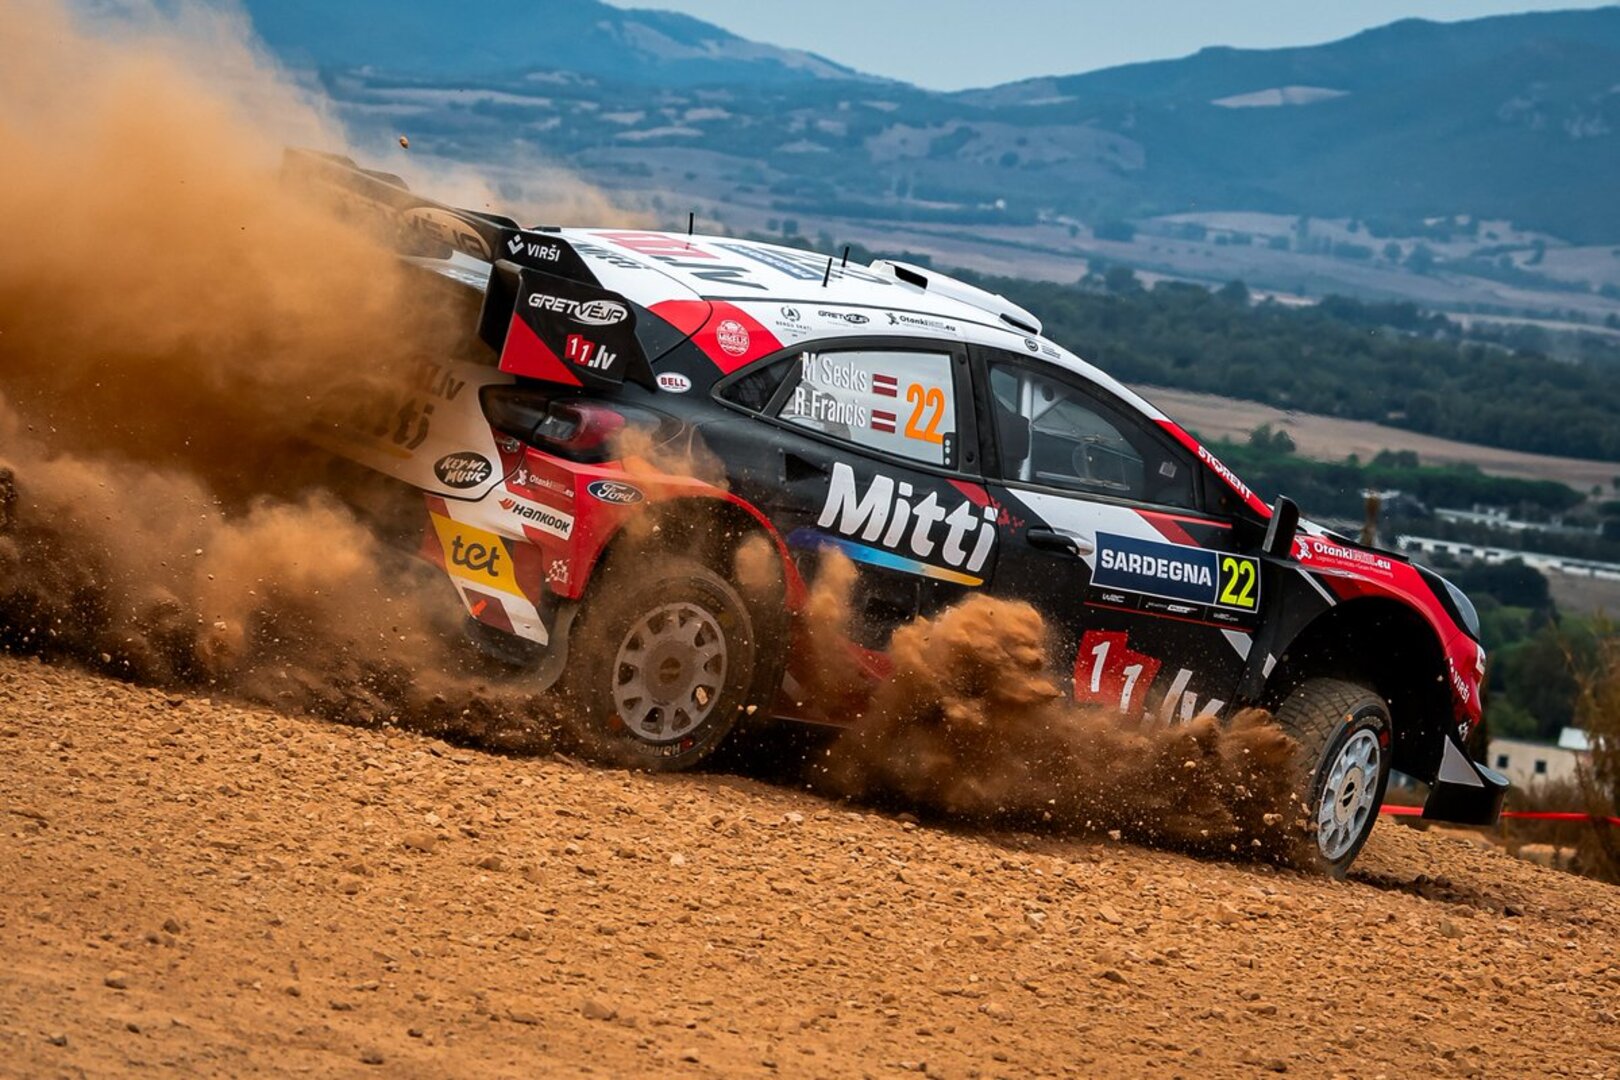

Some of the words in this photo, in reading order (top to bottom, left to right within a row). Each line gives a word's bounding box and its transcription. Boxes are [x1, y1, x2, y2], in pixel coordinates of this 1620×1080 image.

[527, 243, 561, 263] VIRŠI
[560, 337, 617, 371] 11.lv
[802, 352, 817, 382] M
[822, 357, 868, 393] Sesks
[660, 376, 687, 388] BELL
[795, 386, 805, 416] R
[811, 389, 867, 429] Francis
[904, 382, 945, 446] 22
[444, 470, 487, 483] MUSIC
[597, 482, 636, 503] Ford
[817, 461, 998, 573] Mitti
[452, 535, 500, 577] tet
[1101, 548, 1212, 587] SARDEGNA
[1219, 557, 1256, 608] 22
